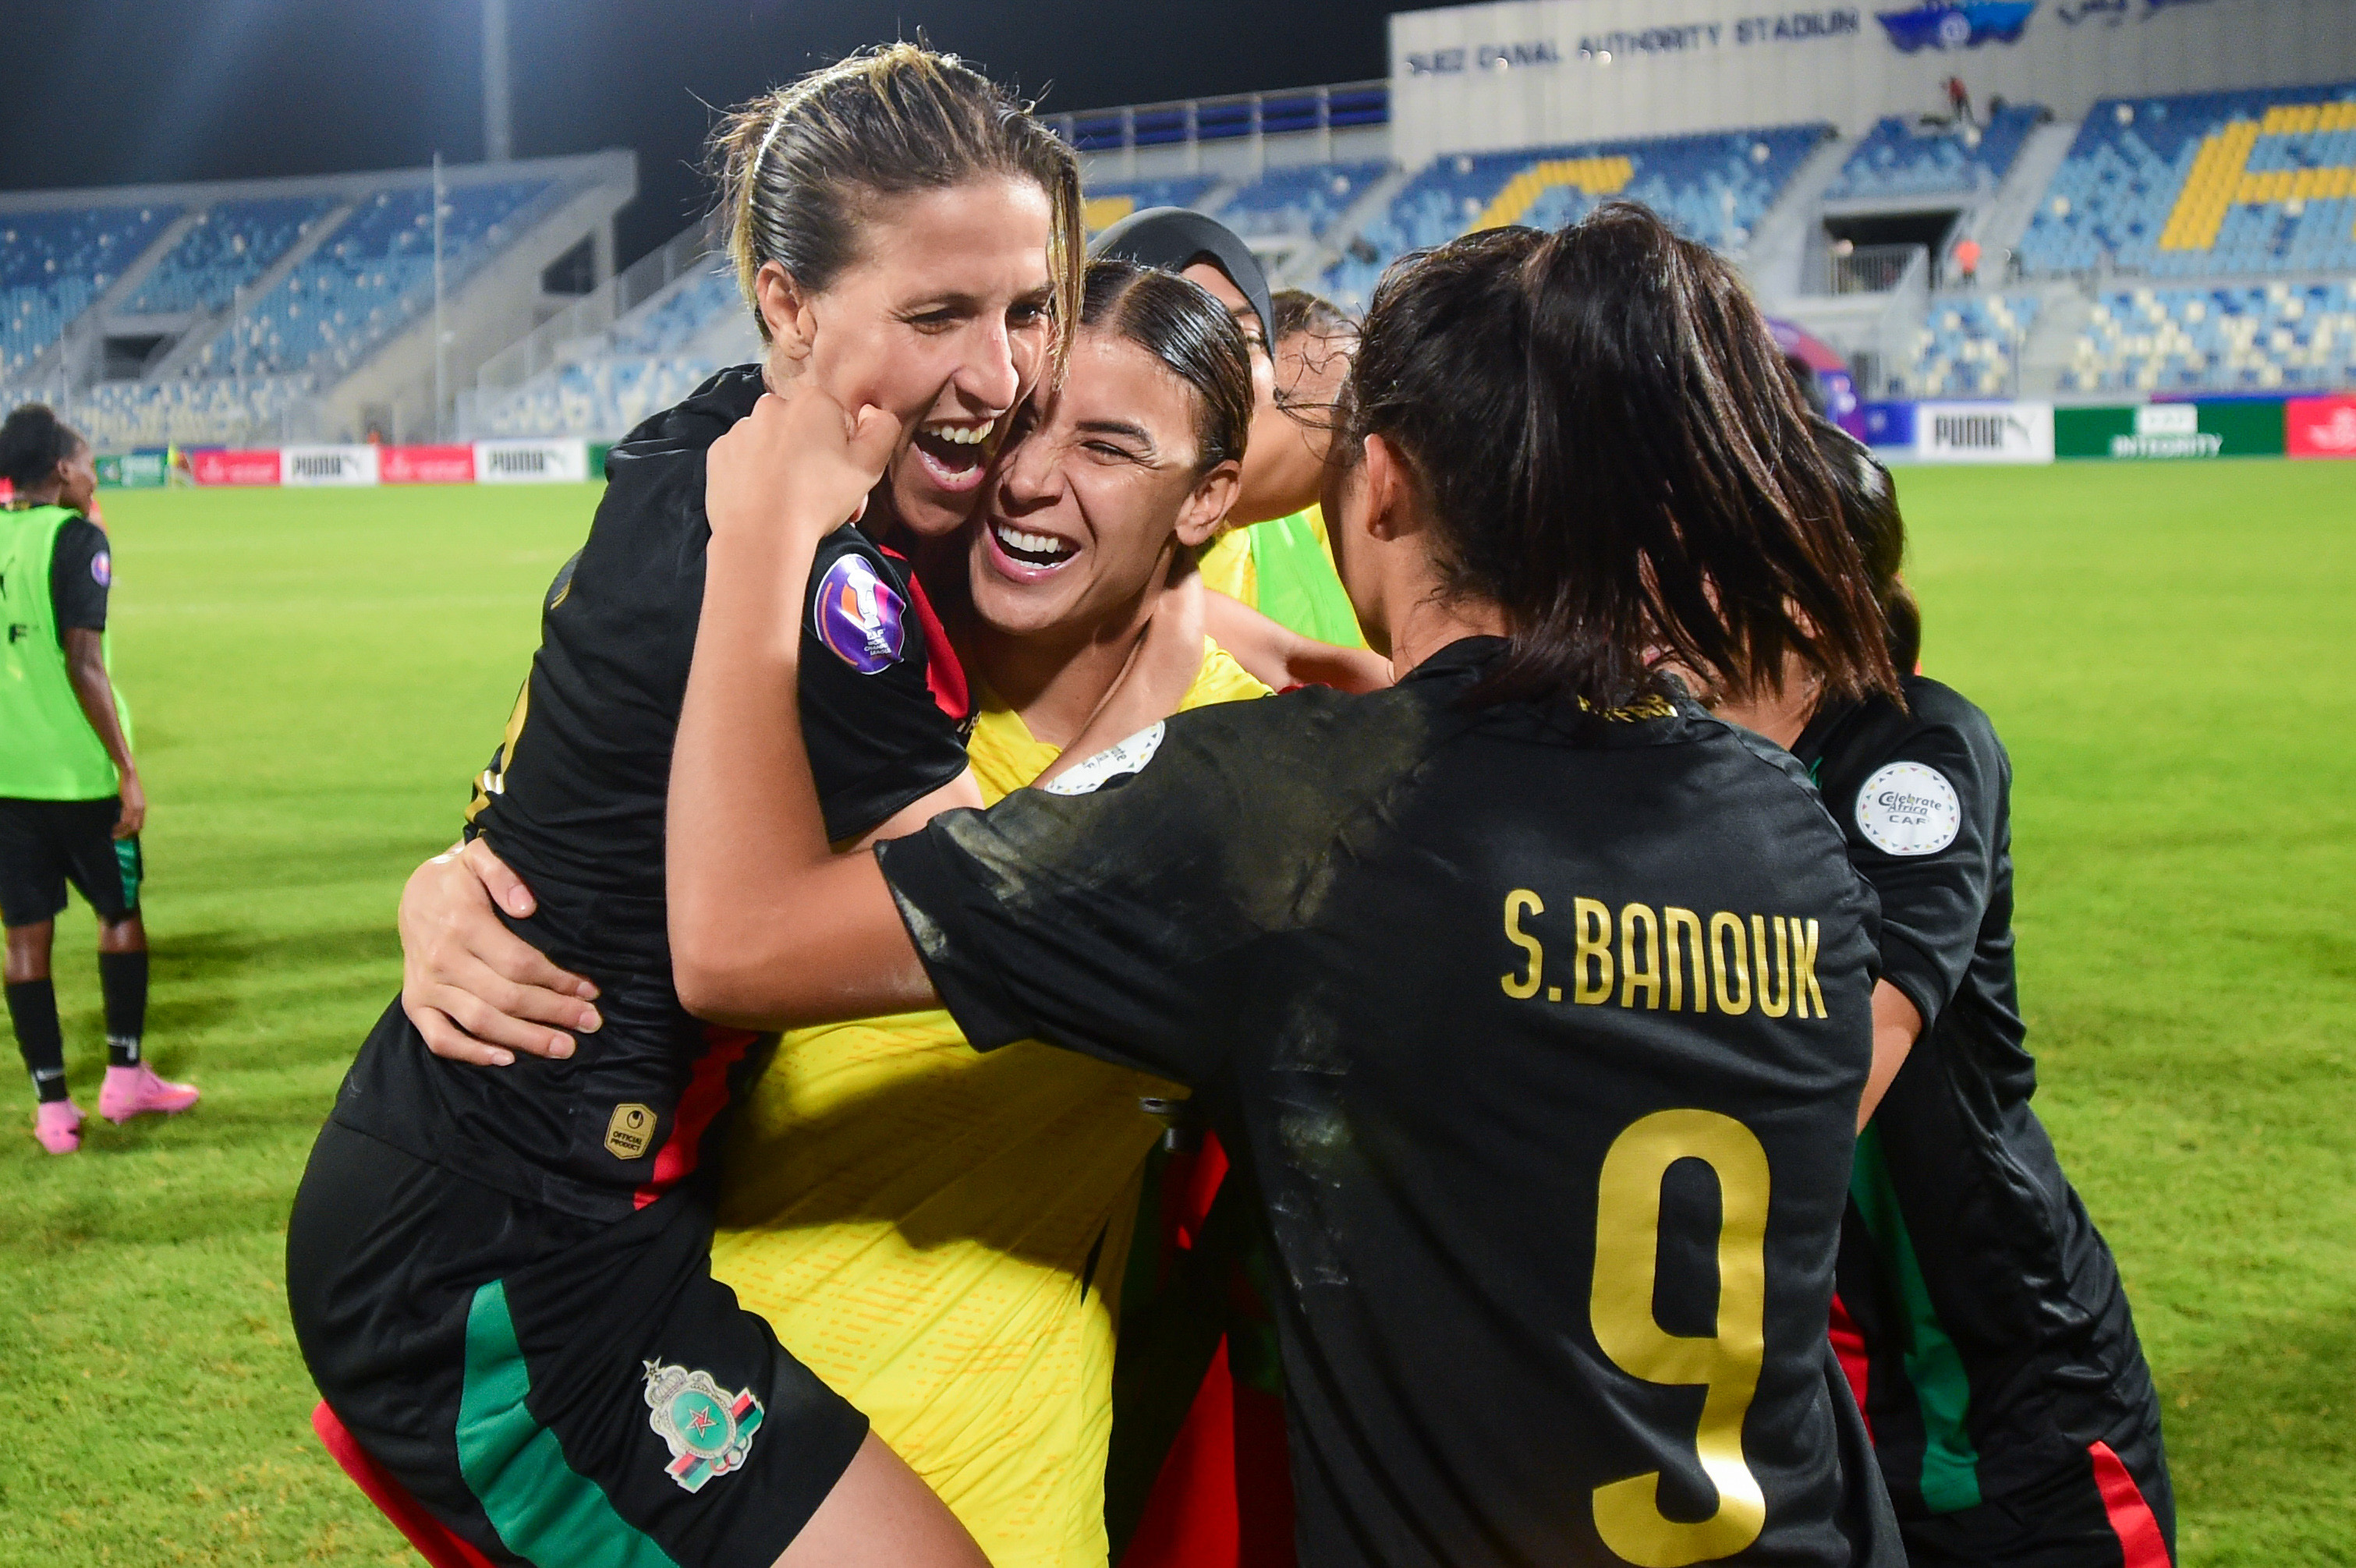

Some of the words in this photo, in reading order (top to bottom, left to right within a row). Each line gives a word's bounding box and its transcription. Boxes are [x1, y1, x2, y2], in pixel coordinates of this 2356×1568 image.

[1478, 41, 1562, 70] CANAL
[1578, 22, 1721, 56] AUTHORITY
[1736, 9, 1861, 44] STADIUM
[1936, 414, 2003, 448] PUMA
[1878, 791, 1942, 811] Celebrate
[1887, 803, 1928, 816] Africa
[1889, 815, 1926, 825] CAF
[1500, 888, 1828, 1019] S.BANOUK
[610, 1138, 640, 1151] PRODUCT
[613, 1131, 642, 1145] OFFICIAL
[1590, 1108, 1771, 1568] 9
